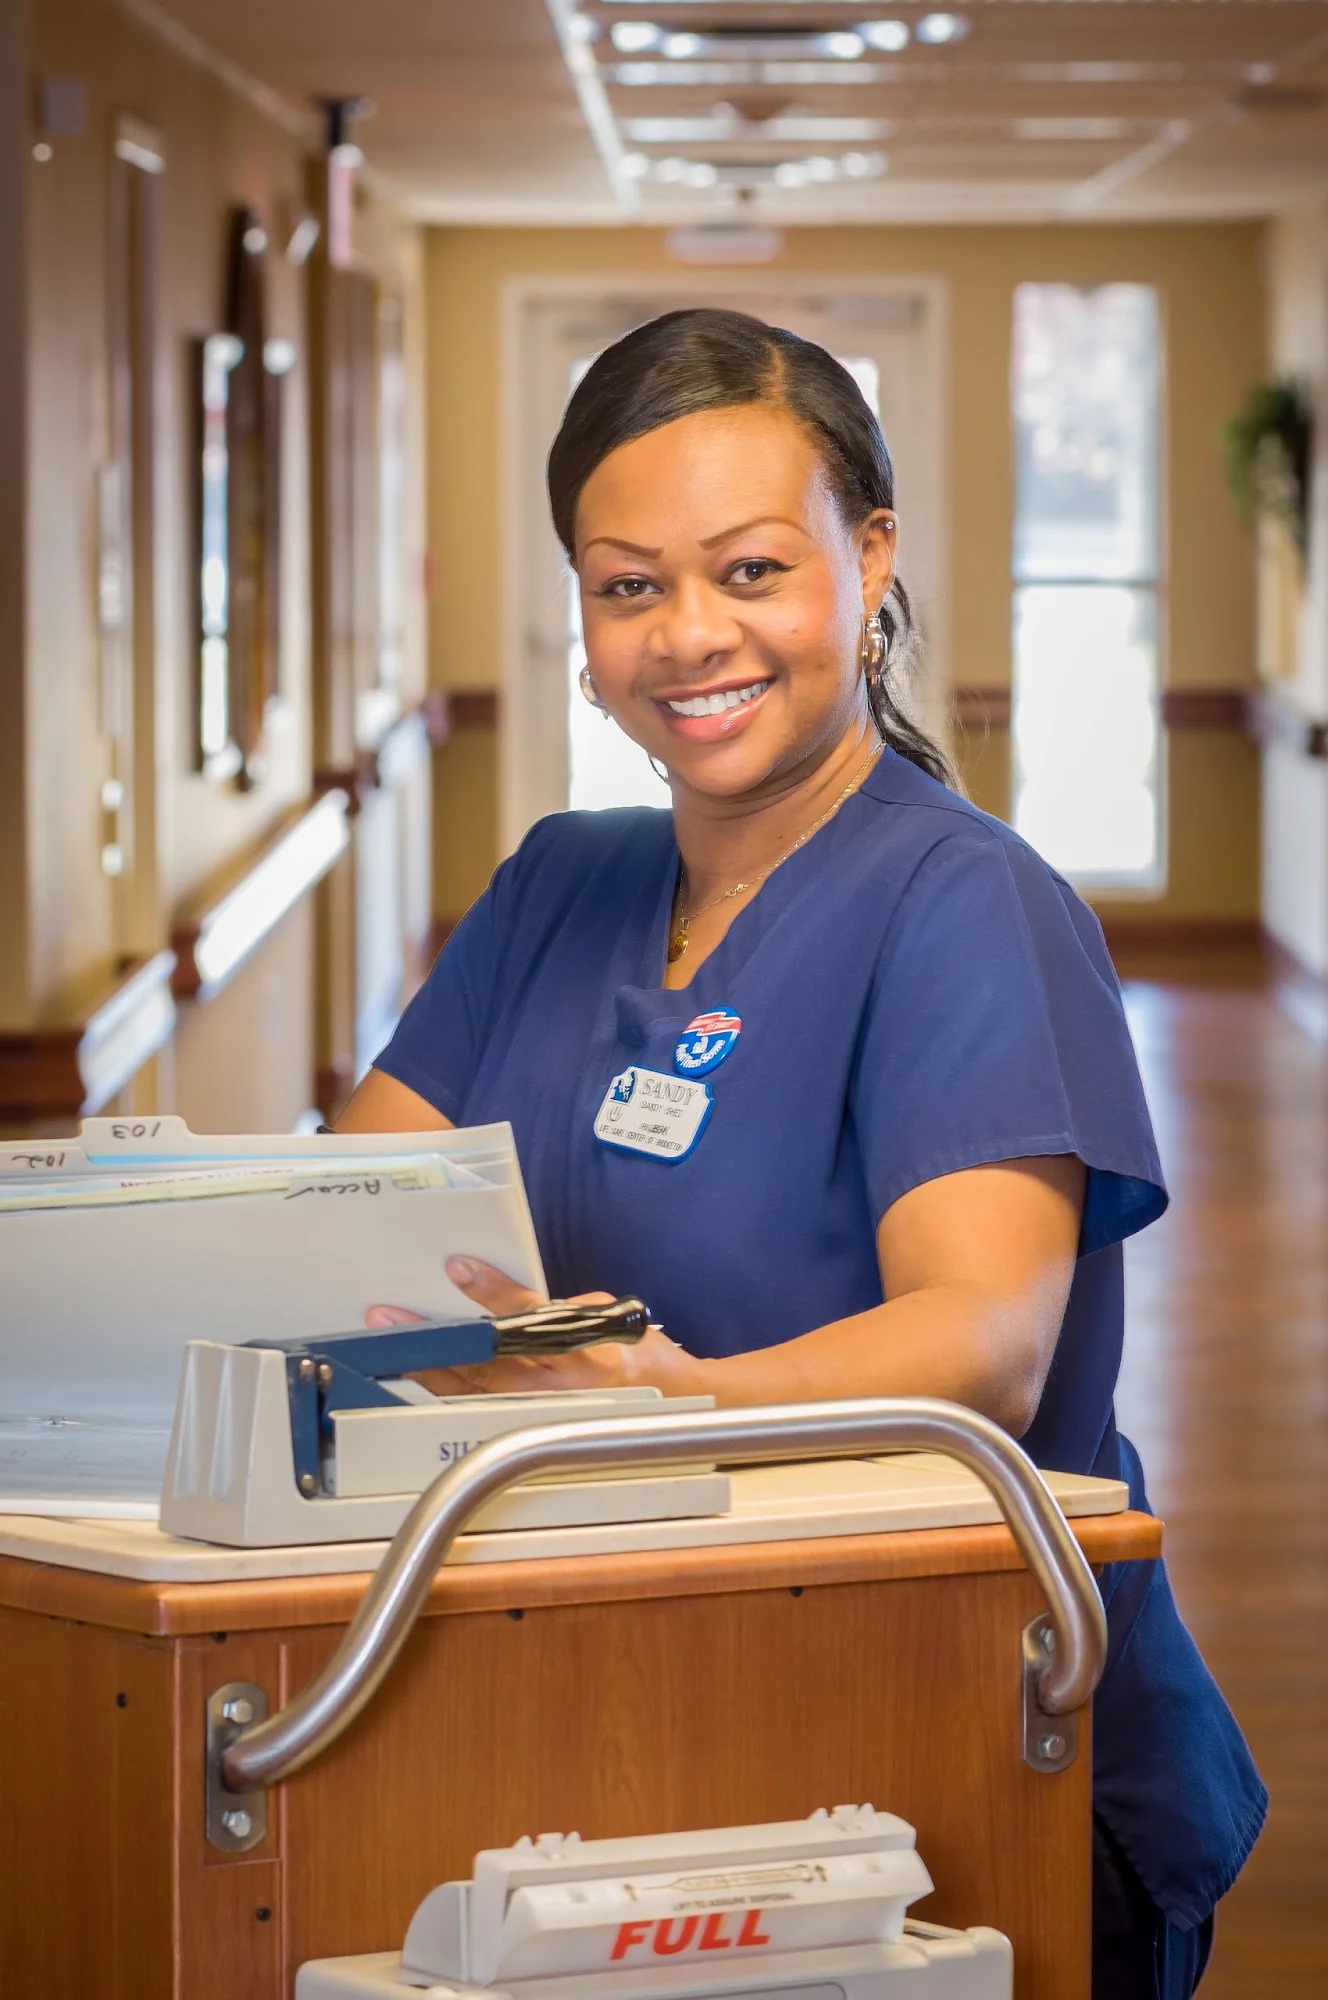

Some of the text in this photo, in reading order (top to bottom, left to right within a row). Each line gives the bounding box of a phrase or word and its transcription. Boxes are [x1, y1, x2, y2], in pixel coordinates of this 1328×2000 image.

[641, 1078, 699, 1106] SANDY
[111, 1122, 161, 1139] 103
[12, 1152, 66, 1168] 102
[609, 1908, 771, 1961] FULL
